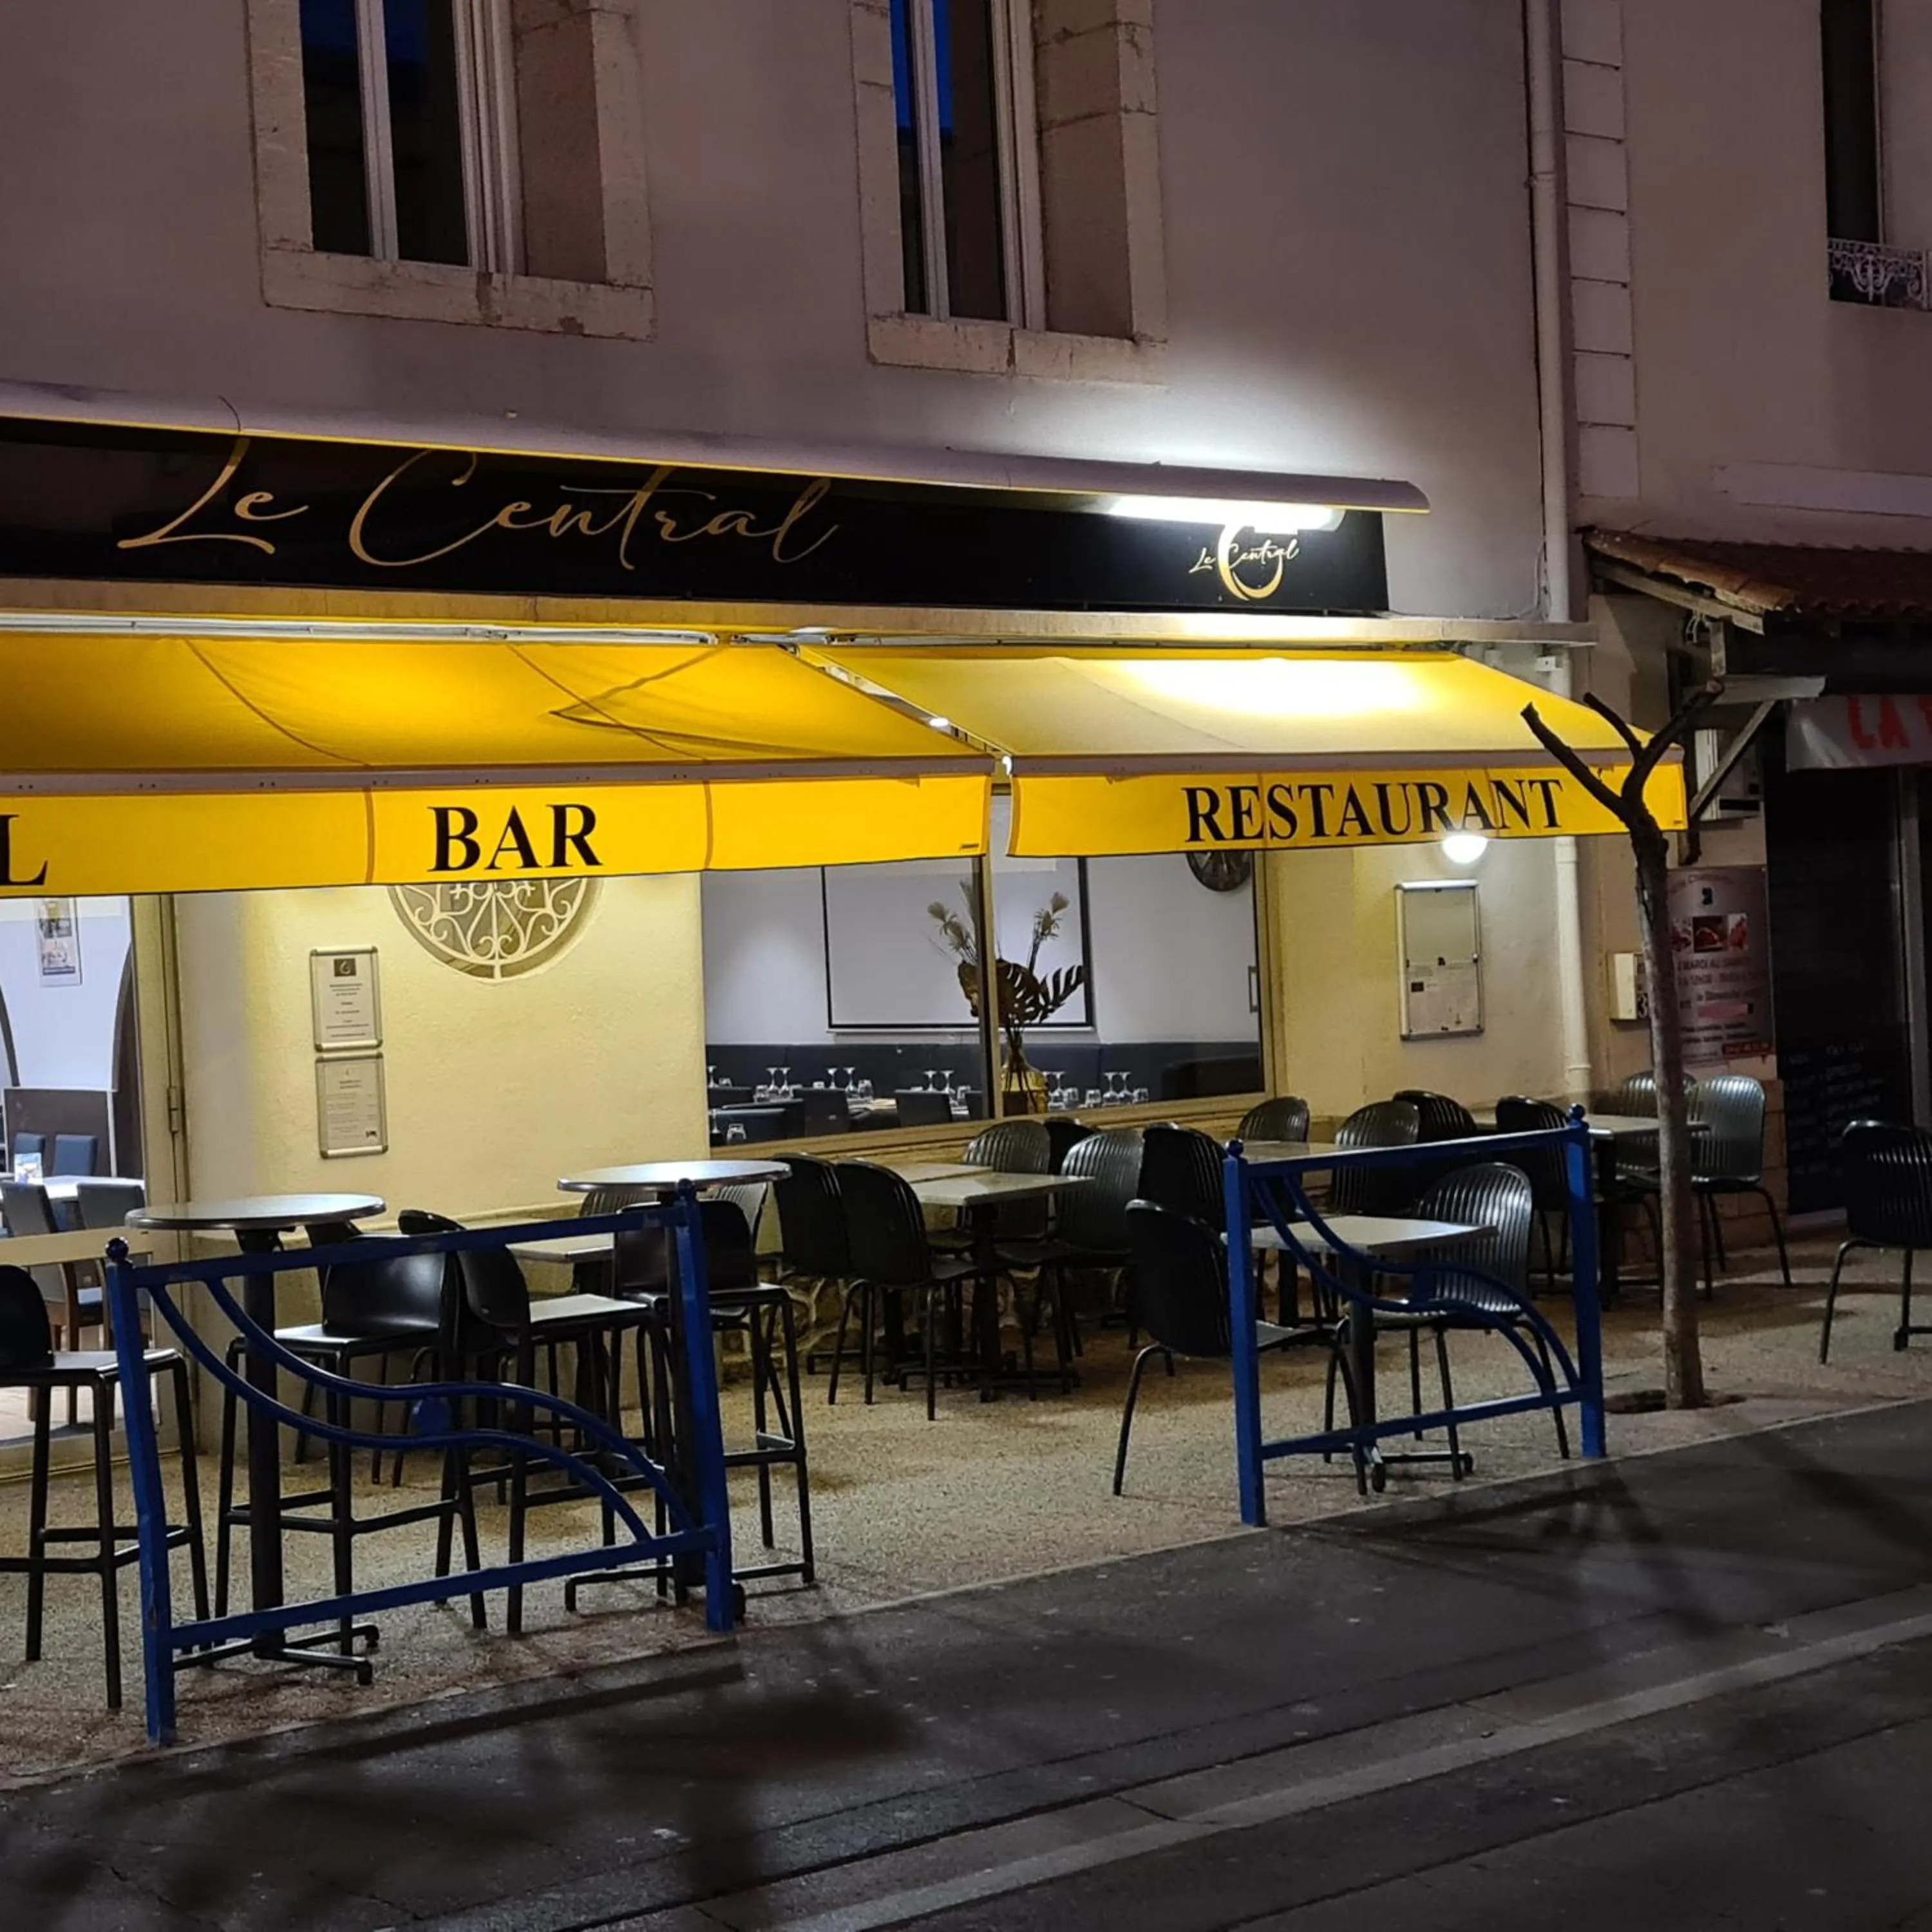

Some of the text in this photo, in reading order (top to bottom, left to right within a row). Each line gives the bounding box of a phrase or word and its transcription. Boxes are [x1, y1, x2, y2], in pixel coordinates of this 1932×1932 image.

[117, 438, 838, 570] Le Central
[1188, 547, 1216, 574] Le
[426, 803, 603, 872] BAR
[1180, 779, 1564, 842] RESTAURANT
